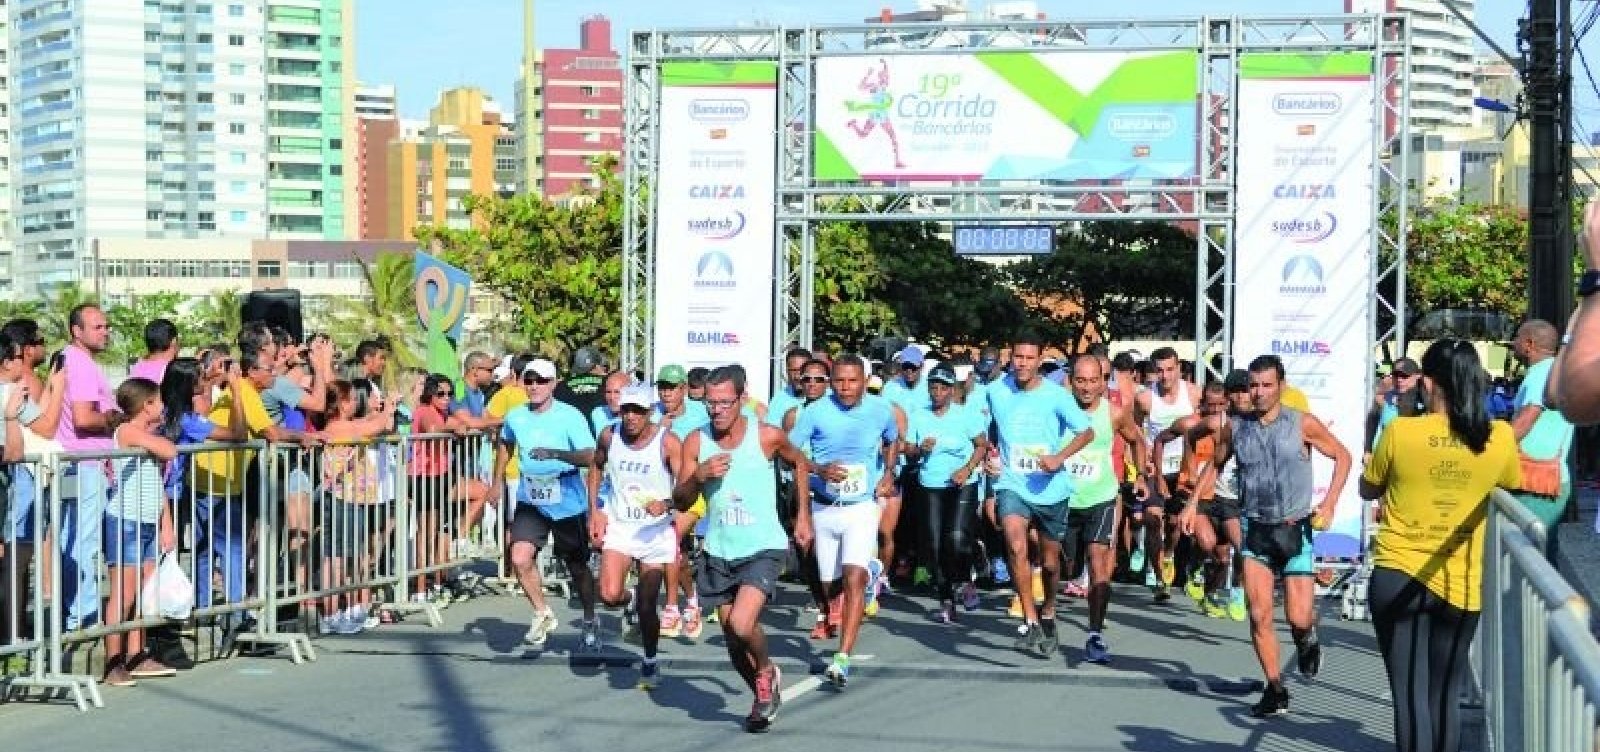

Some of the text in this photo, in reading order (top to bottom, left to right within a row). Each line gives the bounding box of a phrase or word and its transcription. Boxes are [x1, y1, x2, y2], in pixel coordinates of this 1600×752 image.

[898, 93, 997, 118] Corrida
[689, 185, 745, 199] CAIXA
[1273, 184, 1336, 199] CAIXA
[687, 216, 733, 231] sudesb
[1271, 217, 1322, 232] sudesb
[687, 331, 730, 344] BAHIA
[1271, 340, 1321, 354] BAHIA
[1071, 462, 1095, 478] 277
